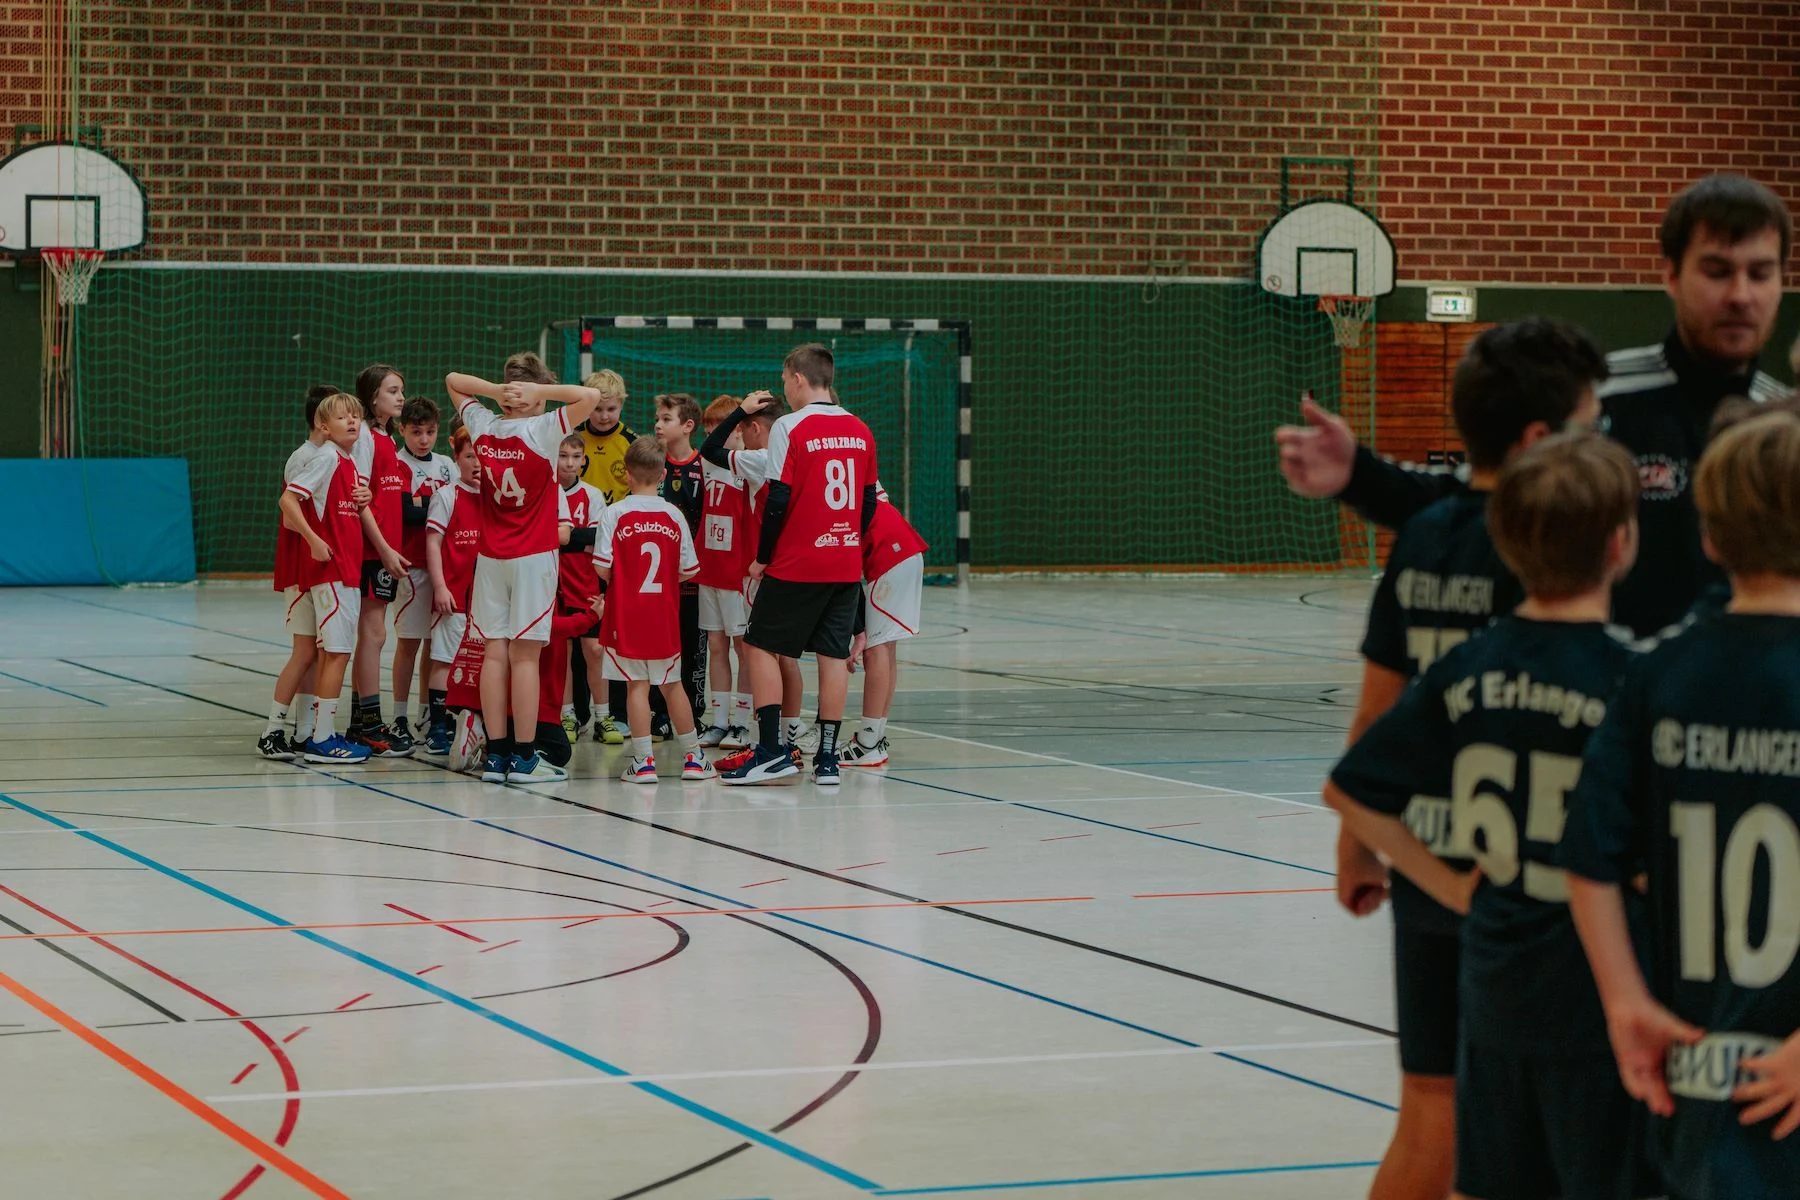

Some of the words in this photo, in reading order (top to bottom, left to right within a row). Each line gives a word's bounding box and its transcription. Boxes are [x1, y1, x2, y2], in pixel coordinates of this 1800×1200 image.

[806, 438, 821, 452] HC
[485, 466, 526, 506] 14
[688, 471, 701, 480] REW
[824, 458, 855, 510] 81
[705, 480, 726, 507] 17
[573, 502, 585, 525] 4
[454, 530, 480, 538] SPORT
[616, 526, 633, 541] HC
[634, 521, 680, 543] Sulzbach
[710, 523, 725, 542] ifg
[639, 541, 662, 594] 2
[1481, 670, 1606, 728] Erlange
[1452, 742, 1585, 901] 65
[1669, 802, 1800, 989] 10
